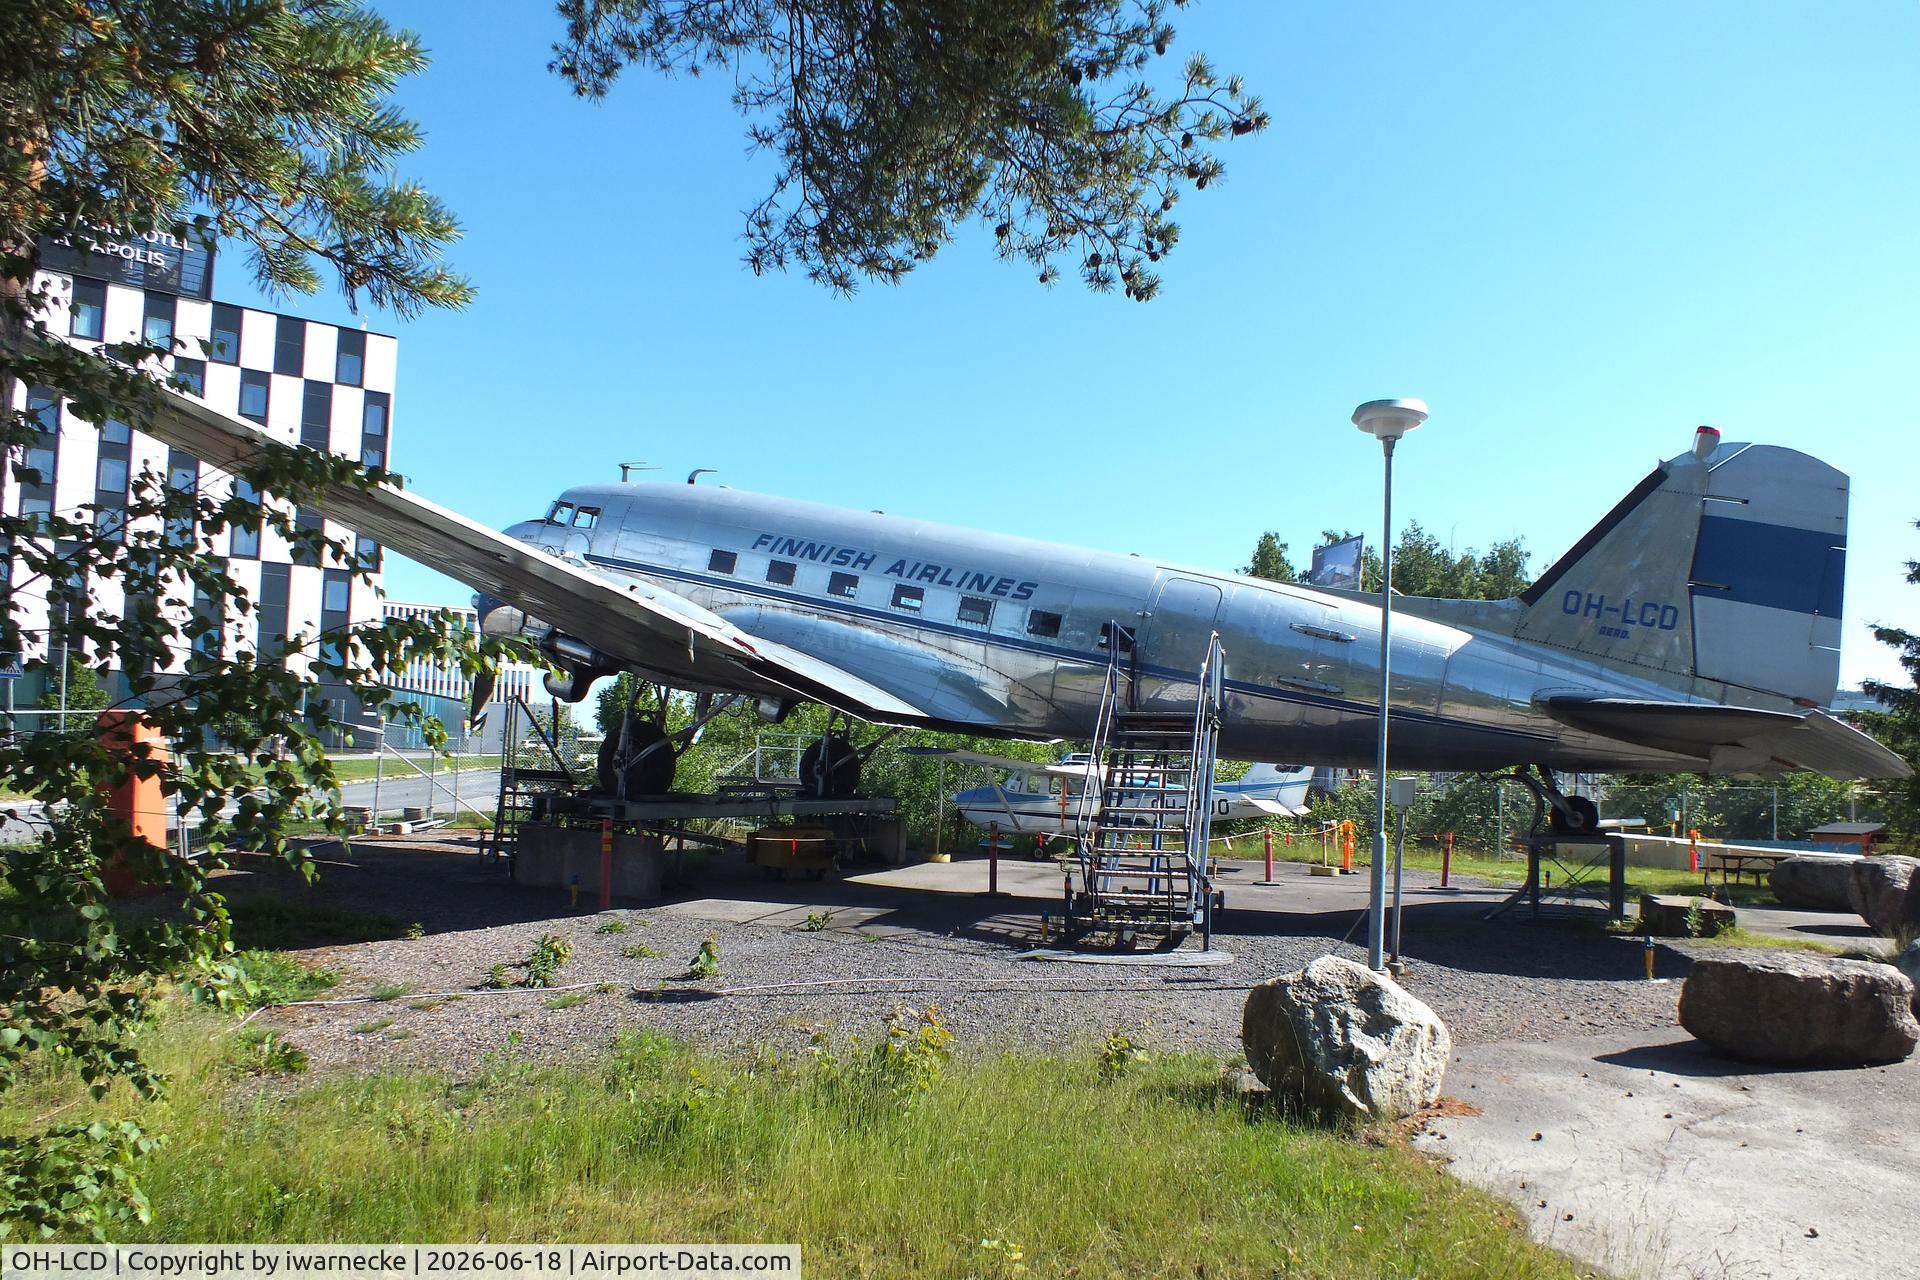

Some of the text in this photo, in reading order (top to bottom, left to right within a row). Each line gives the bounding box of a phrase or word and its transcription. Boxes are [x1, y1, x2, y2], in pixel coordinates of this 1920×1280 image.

[137, 228, 194, 252] OTEL
[752, 533, 1039, 601] FINNISH AIRLINES
[1563, 590, 1679, 631] OH-LCD
